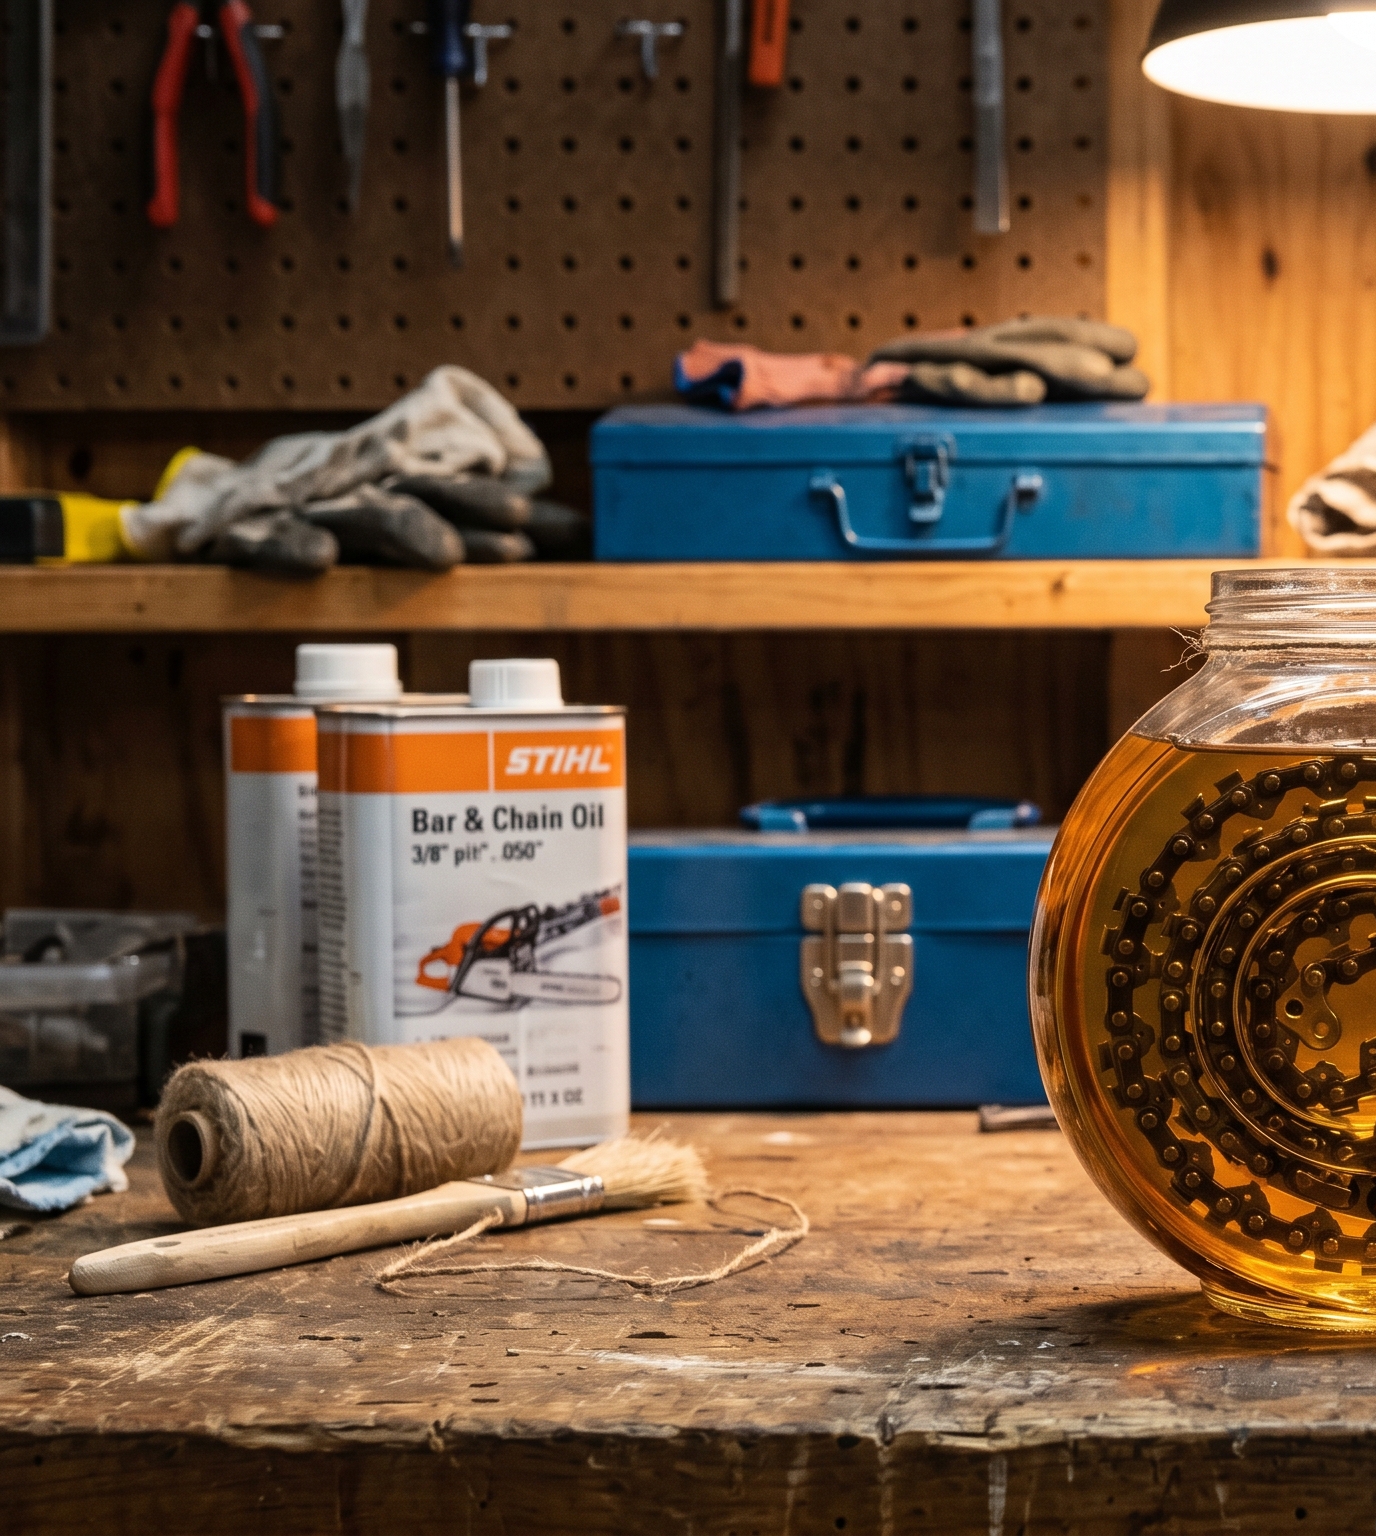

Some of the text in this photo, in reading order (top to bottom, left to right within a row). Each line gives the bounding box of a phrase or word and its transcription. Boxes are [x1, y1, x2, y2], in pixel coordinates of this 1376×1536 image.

[505, 744, 611, 775] STIHL
[412, 803, 604, 833] Bar & Chain Oil
